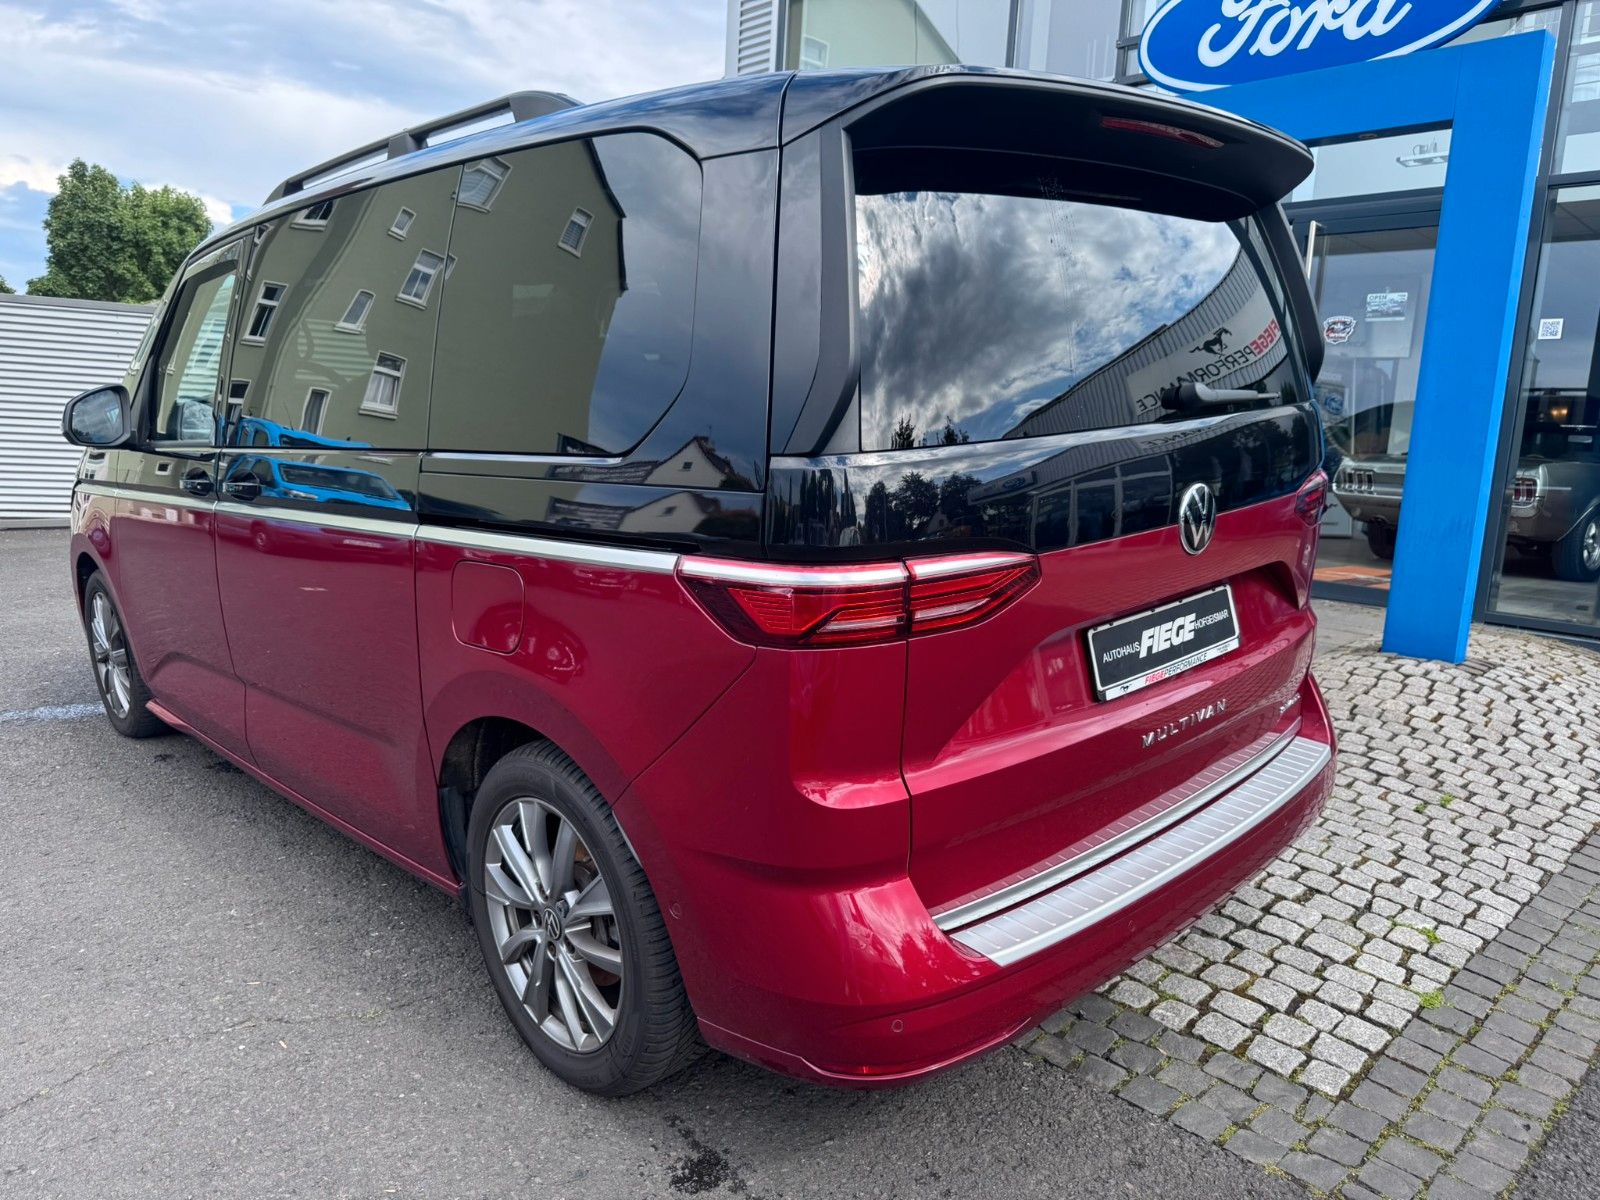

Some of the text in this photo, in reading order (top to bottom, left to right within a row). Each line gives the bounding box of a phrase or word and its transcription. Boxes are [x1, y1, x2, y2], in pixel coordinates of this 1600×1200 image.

[1197, 0, 1413, 67] Ford
[1102, 642, 1140, 664] AUTOHAUS
[1139, 613, 1197, 659] FIEGE
[1194, 609, 1229, 630] HOFGEISMAR
[1142, 698, 1227, 748] MULTIVAN
